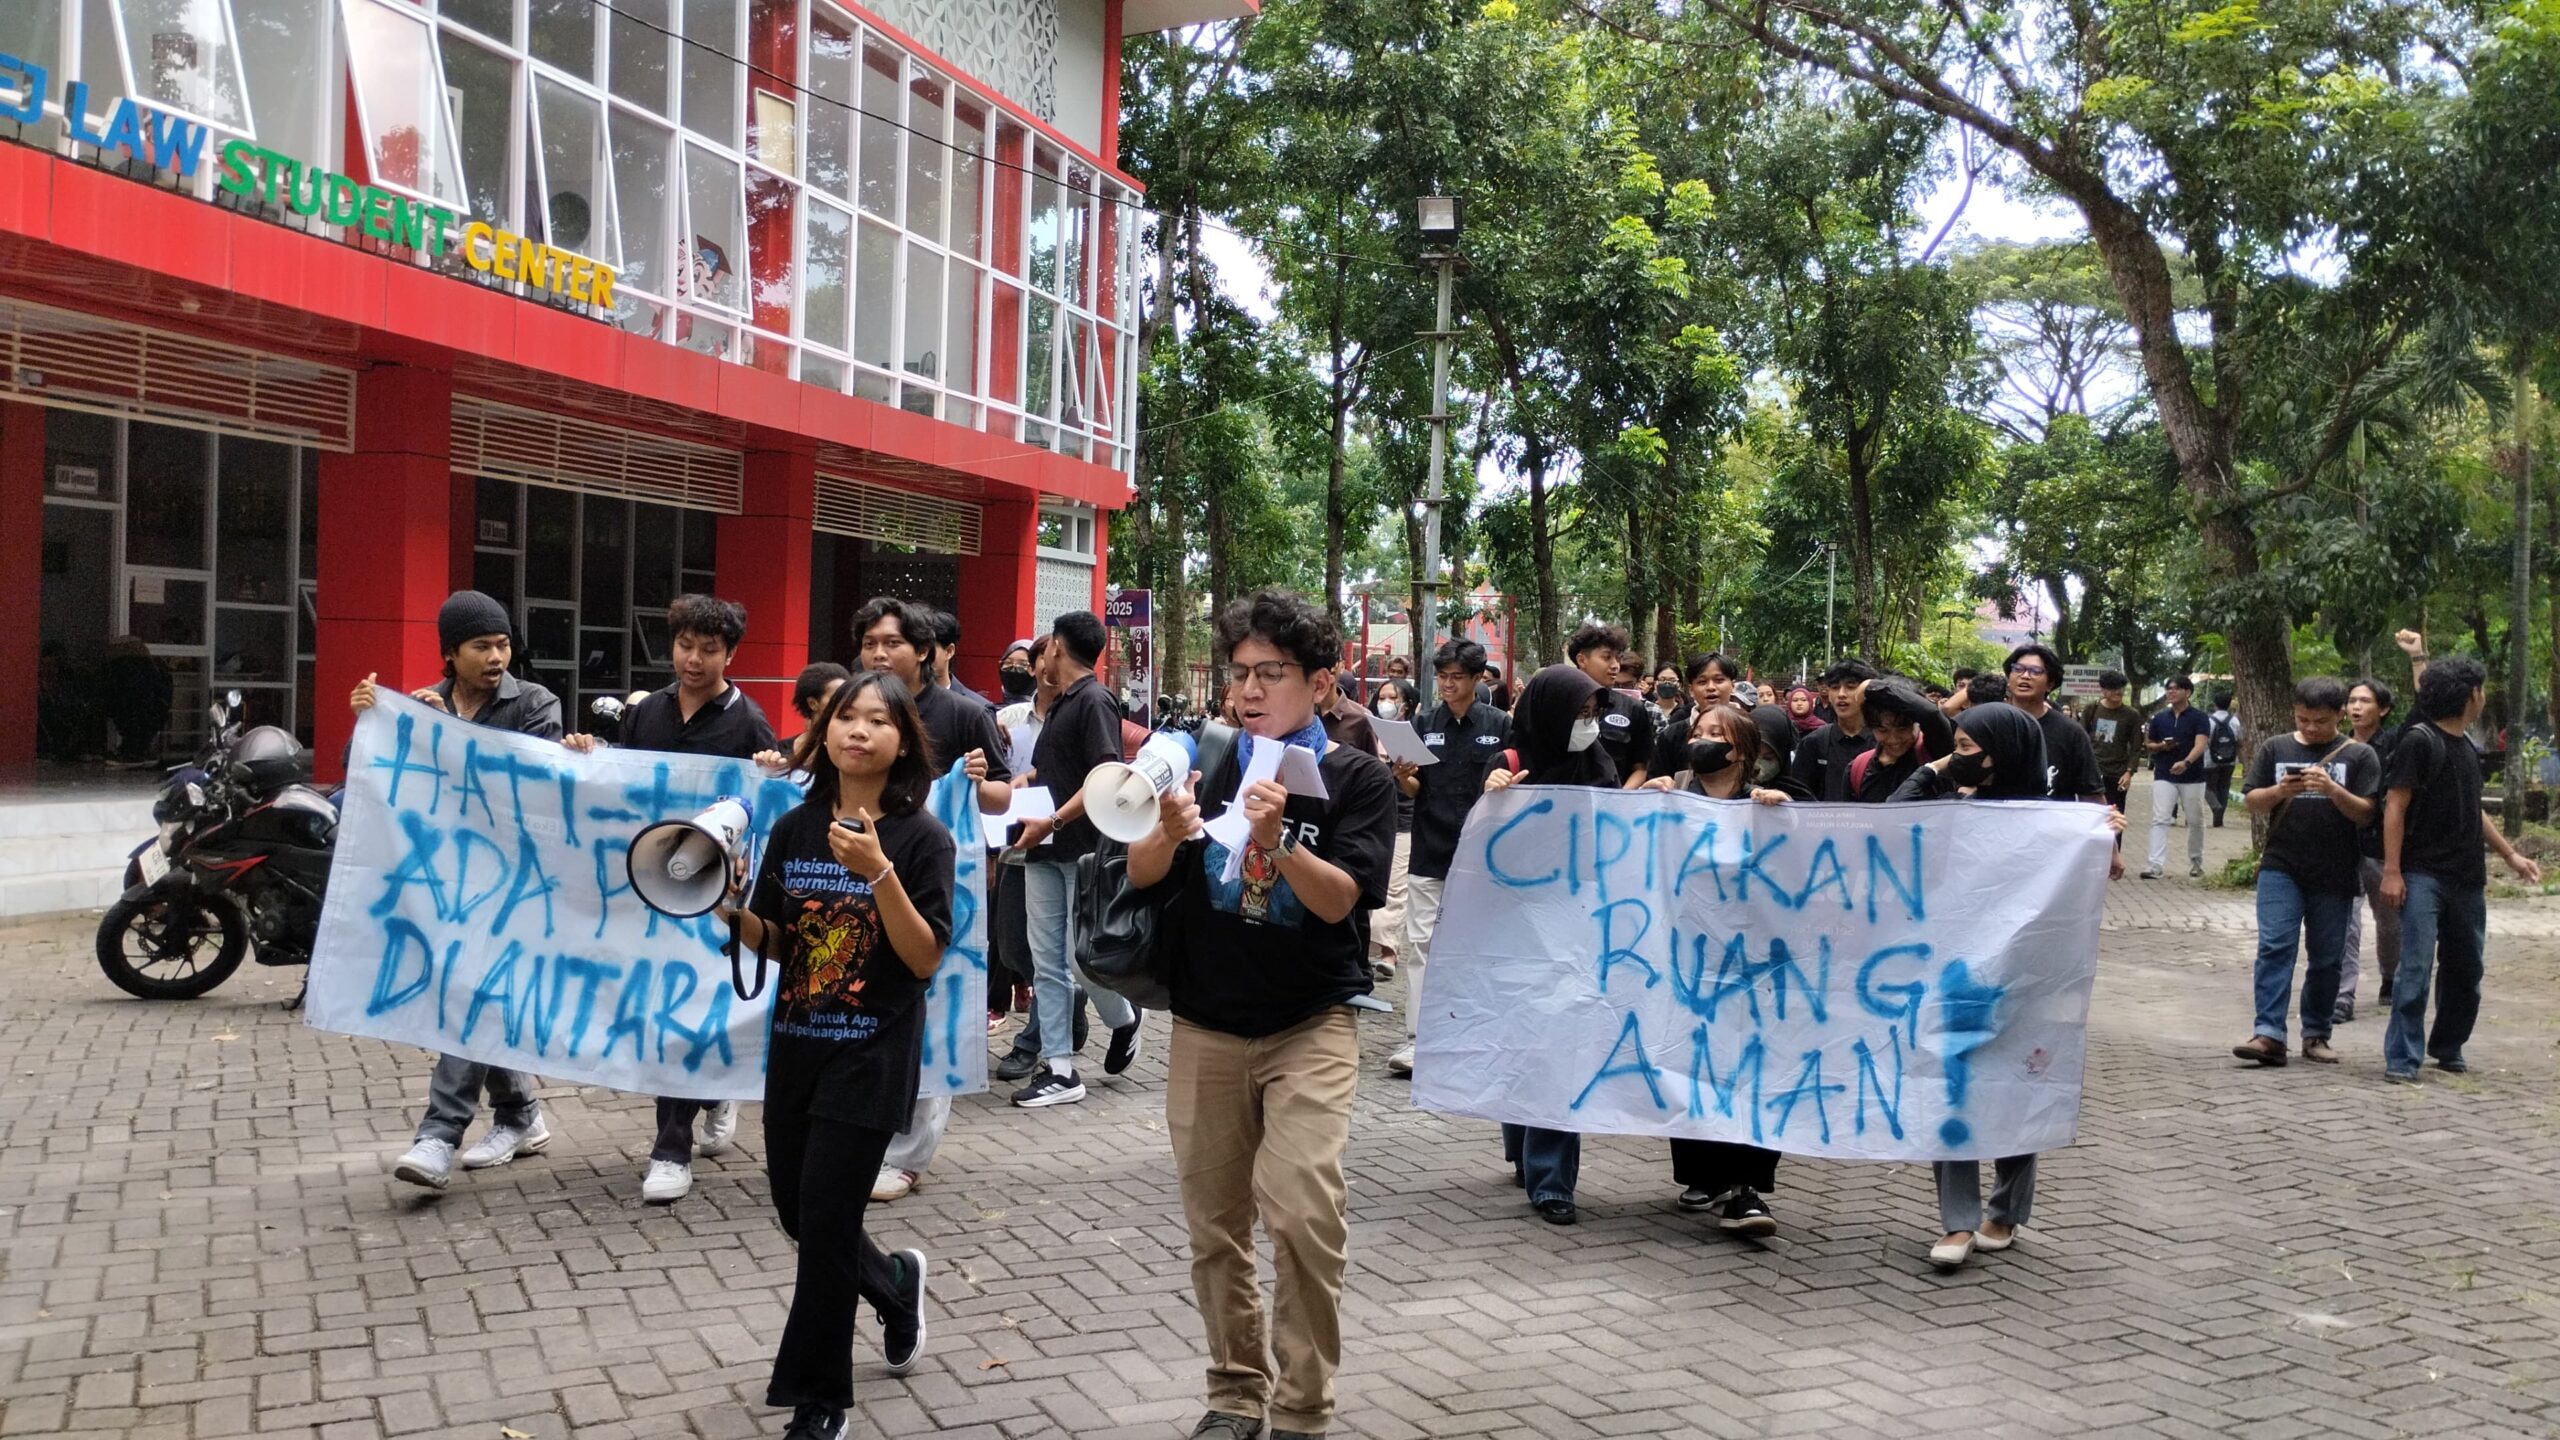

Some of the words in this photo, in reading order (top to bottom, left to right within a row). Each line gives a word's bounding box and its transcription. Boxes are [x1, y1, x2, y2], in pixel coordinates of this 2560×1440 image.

[66, 81, 208, 177] LAW
[220, 138, 454, 257] STUDENT
[463, 221, 616, 309] CENTER
[1106, 602, 1133, 615] 2025
[371, 811, 560, 937] ADA
[783, 857, 848, 876] eksisme
[1485, 799, 1926, 924] CIPTAKAN
[809, 1011, 848, 1025] Untuk
[851, 1014, 878, 1028] Apa
[1592, 898, 1931, 1049] RUANG
